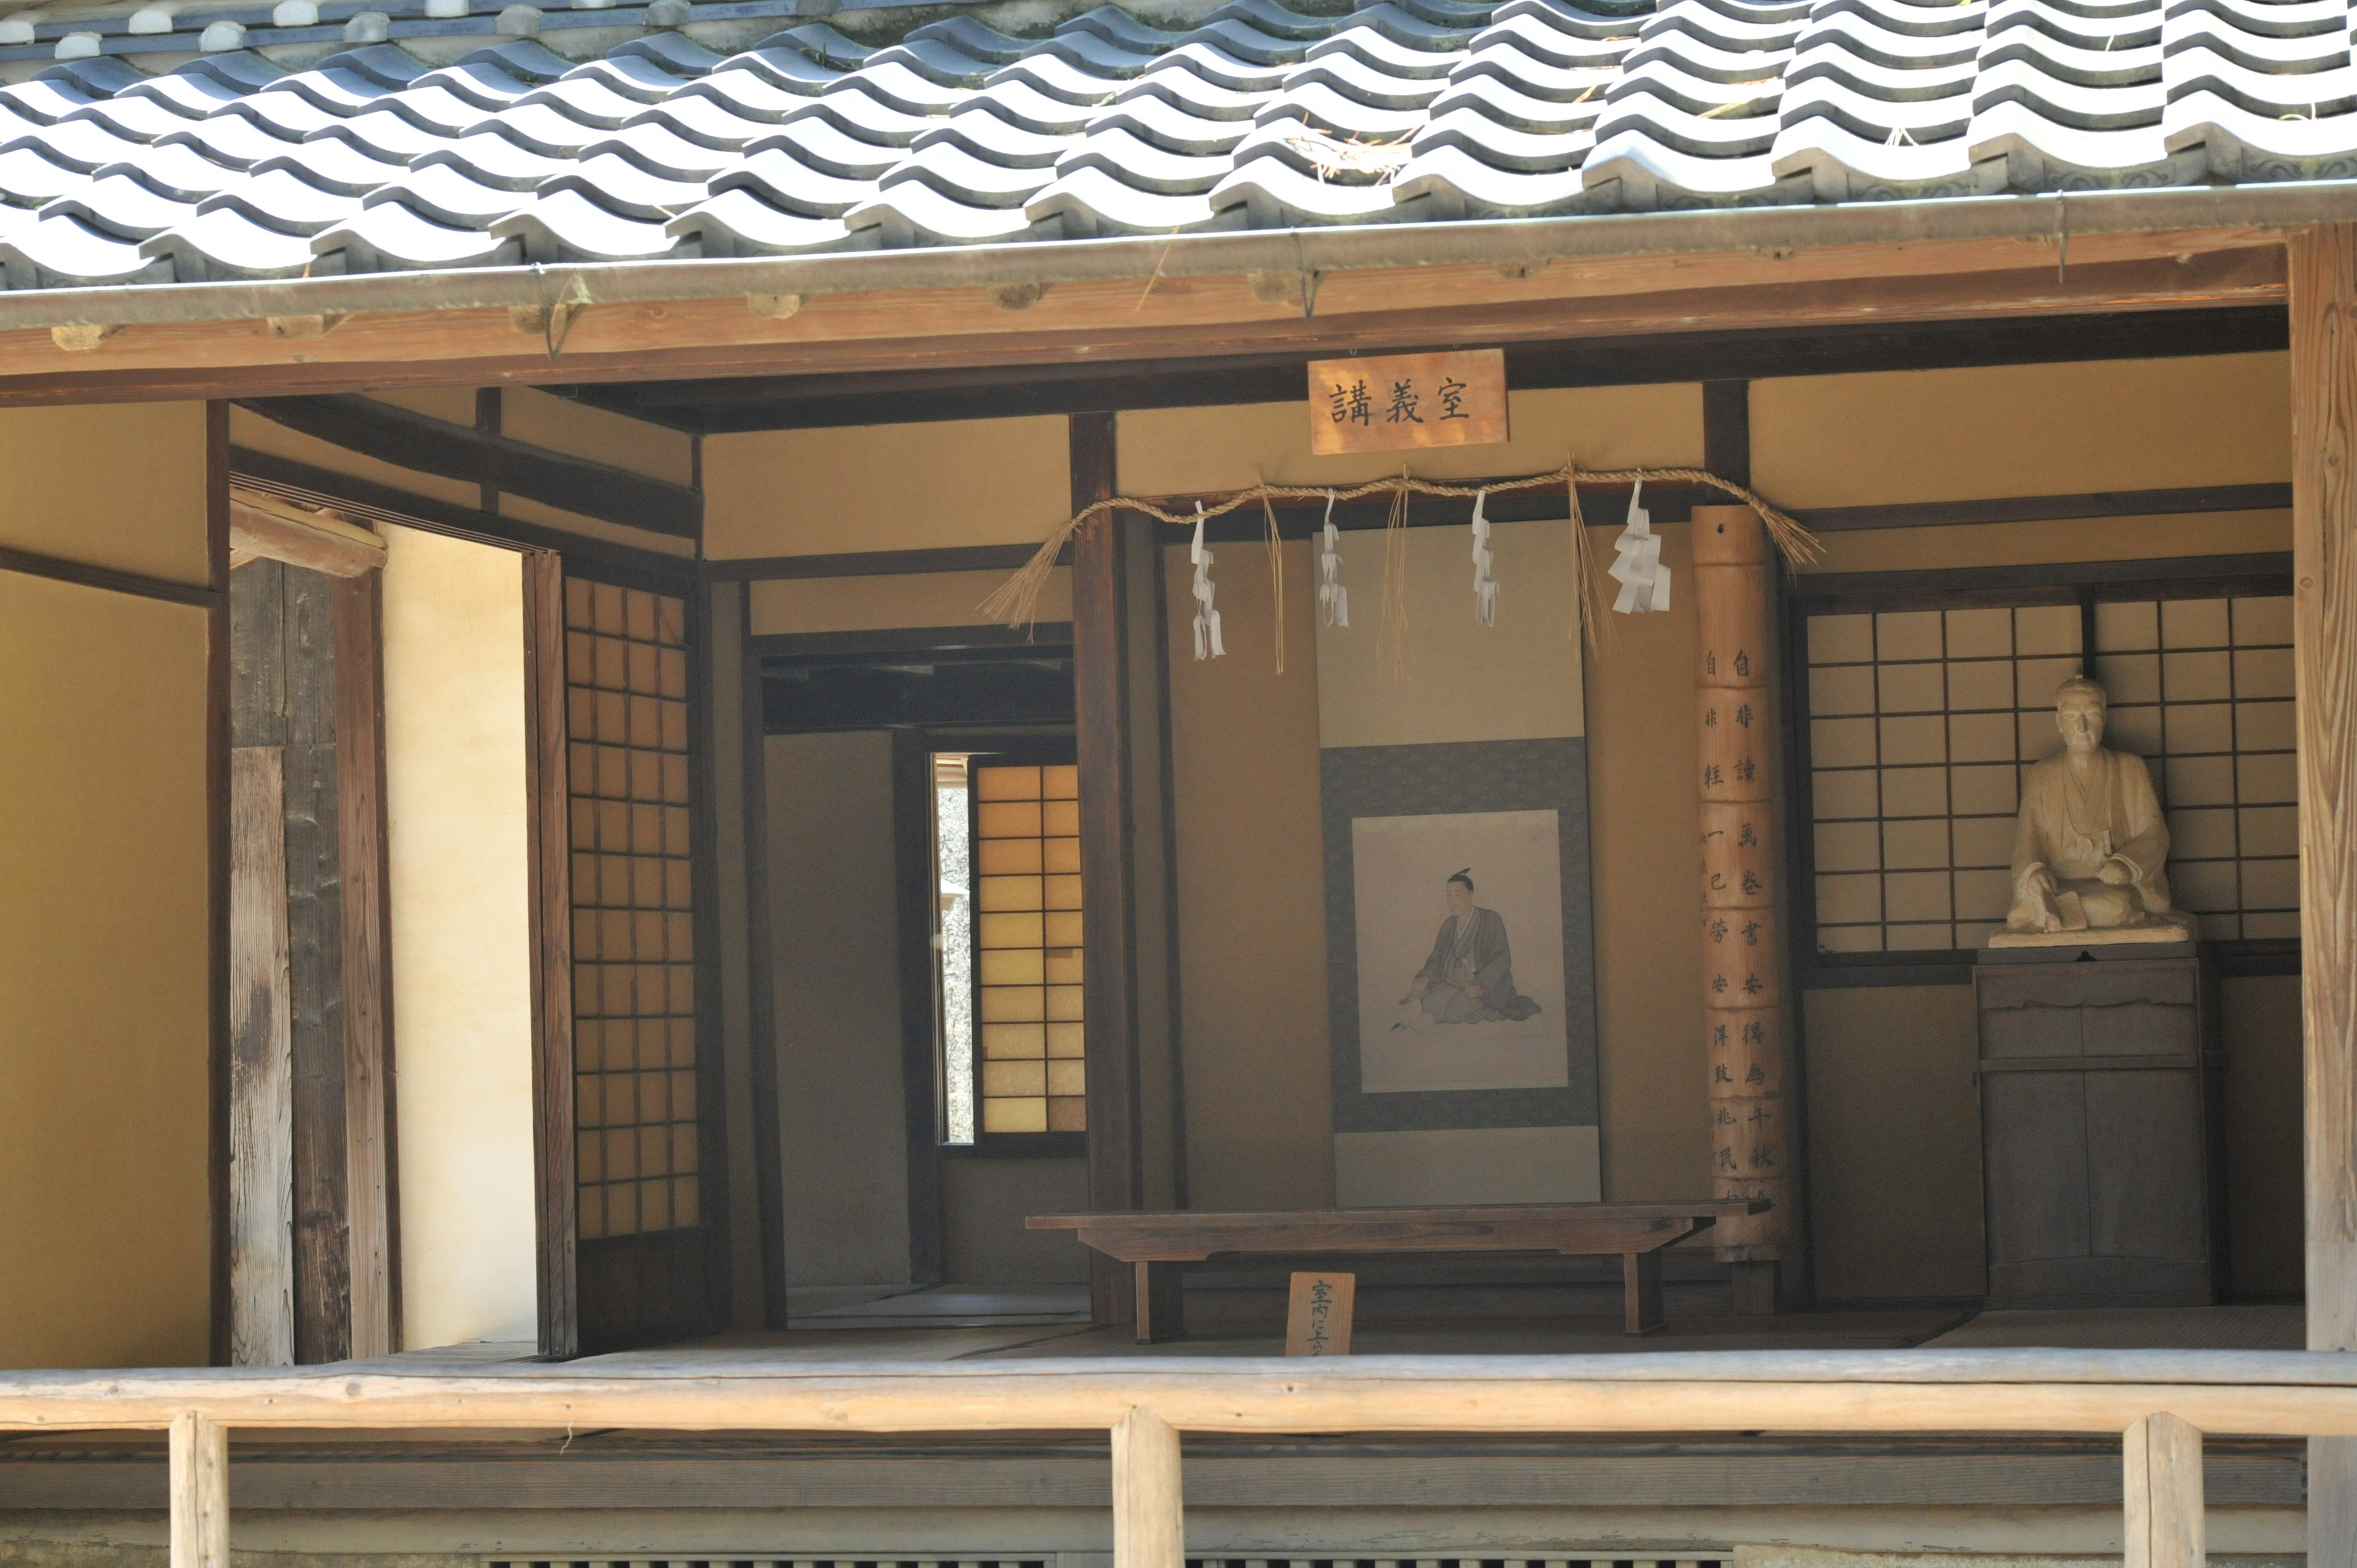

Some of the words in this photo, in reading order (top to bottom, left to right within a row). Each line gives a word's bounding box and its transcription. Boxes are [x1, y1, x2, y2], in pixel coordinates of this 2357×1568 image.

[1329, 376, 1469, 427] 講義室
[1306, 1279, 1333, 1356] 室内に上ら
